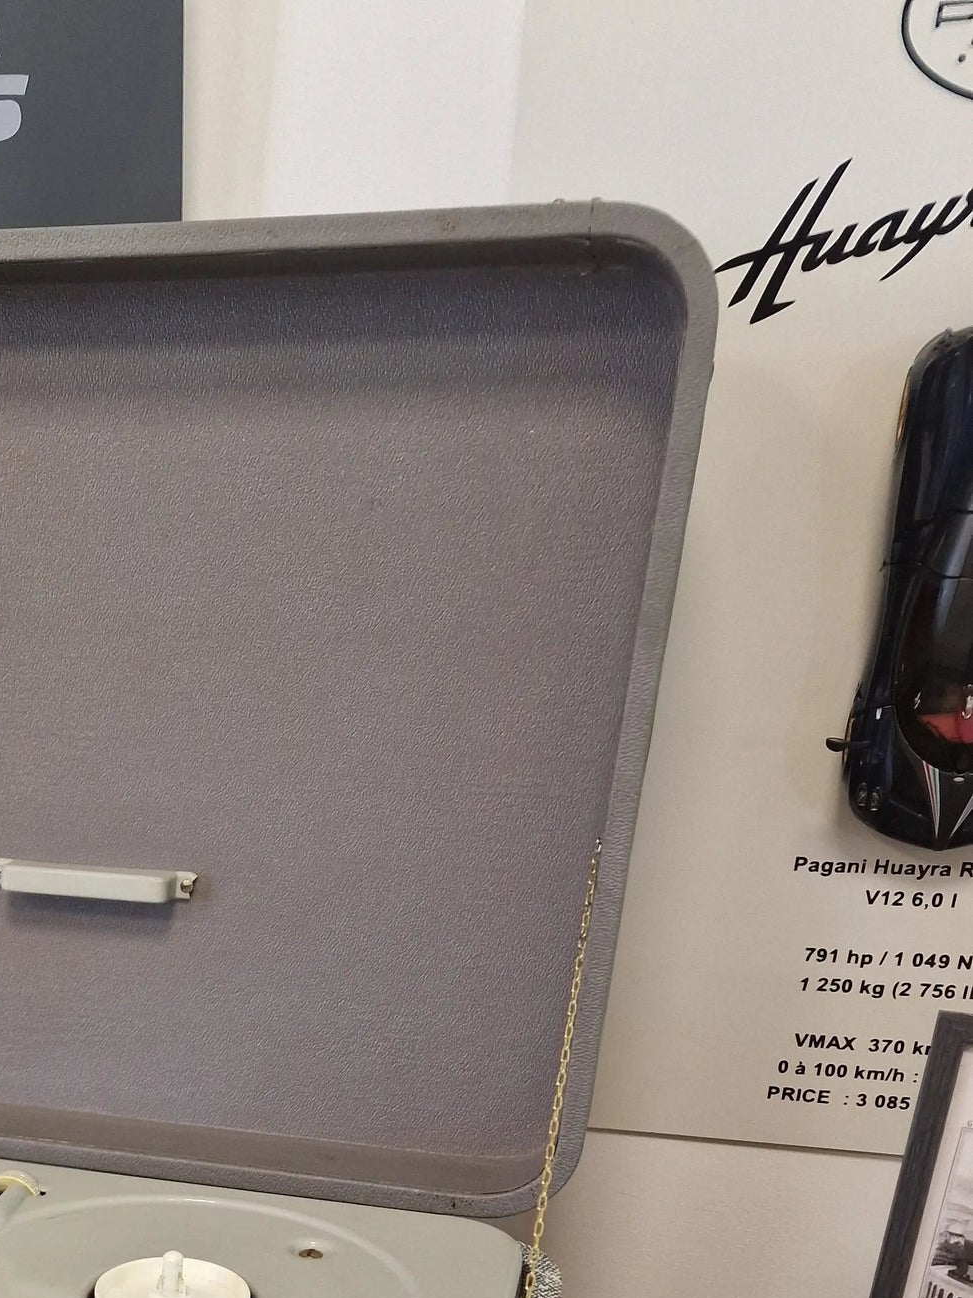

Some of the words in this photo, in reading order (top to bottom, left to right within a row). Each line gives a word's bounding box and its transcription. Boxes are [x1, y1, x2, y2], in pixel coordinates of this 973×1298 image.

[715, 157, 973, 324] Huay
[794, 856, 867, 877] Pagani
[874, 859, 952, 881] Huayra
[866, 890, 905, 907] V12
[912, 892, 944, 909] 6,0
[805, 947, 839, 963] 791
[847, 949, 873, 968] hp
[879, 951, 888, 966] /
[895, 952, 904, 967] 1
[912, 953, 951, 969] 049
[800, 977, 809, 992] 1
[816, 978, 853, 994] 250
[859, 979, 885, 999] kg
[892, 981, 912, 1000] (2
[921, 983, 957, 999] 756
[795, 1032, 857, 1051] VMAX
[868, 1038, 905, 1054] 370
[777, 1060, 789, 1074] 0
[795, 1061, 806, 1075] à
[814, 1062, 848, 1078] 100
[854, 1065, 905, 1082] km/h
[767, 1085, 831, 1104] PRICE
[856, 1093, 868, 1107] 3
[875, 1094, 911, 1110] 085
